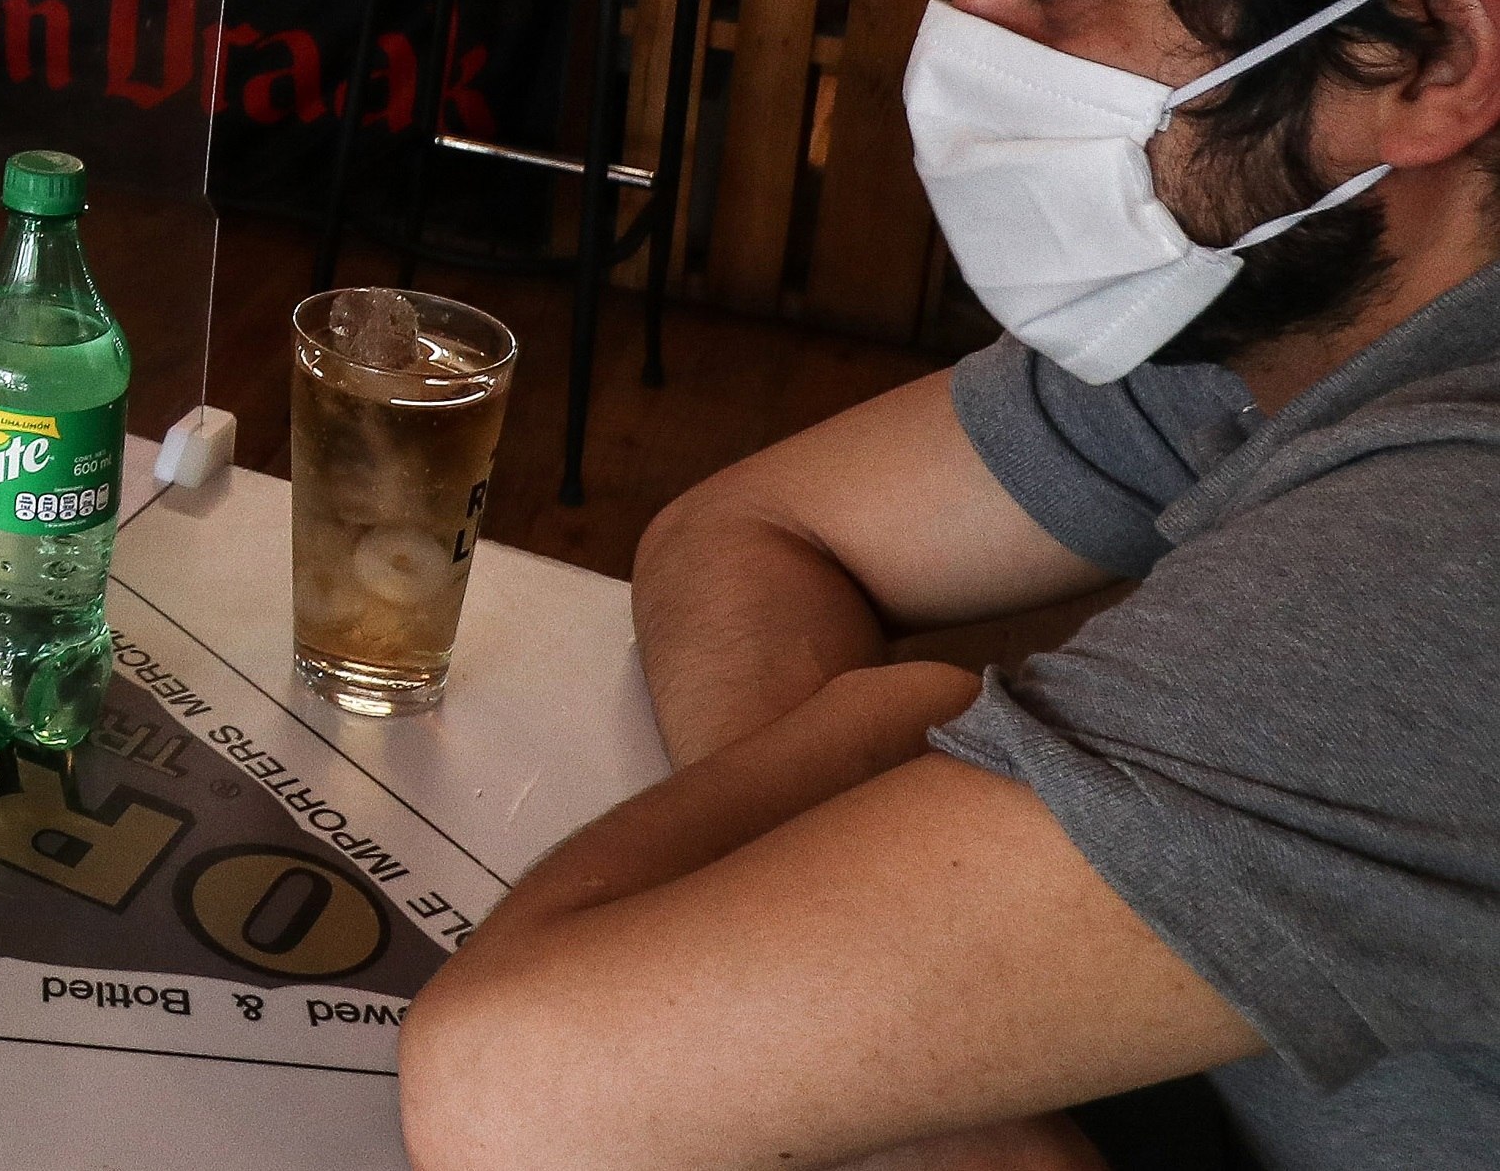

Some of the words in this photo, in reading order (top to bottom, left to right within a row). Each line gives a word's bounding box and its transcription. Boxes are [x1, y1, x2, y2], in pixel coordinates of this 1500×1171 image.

[73, 460, 98, 476] 600
[208, 724, 410, 882] IMPORTERS
[42, 977, 191, 1015] Bottled
[231, 992, 264, 1021] &
